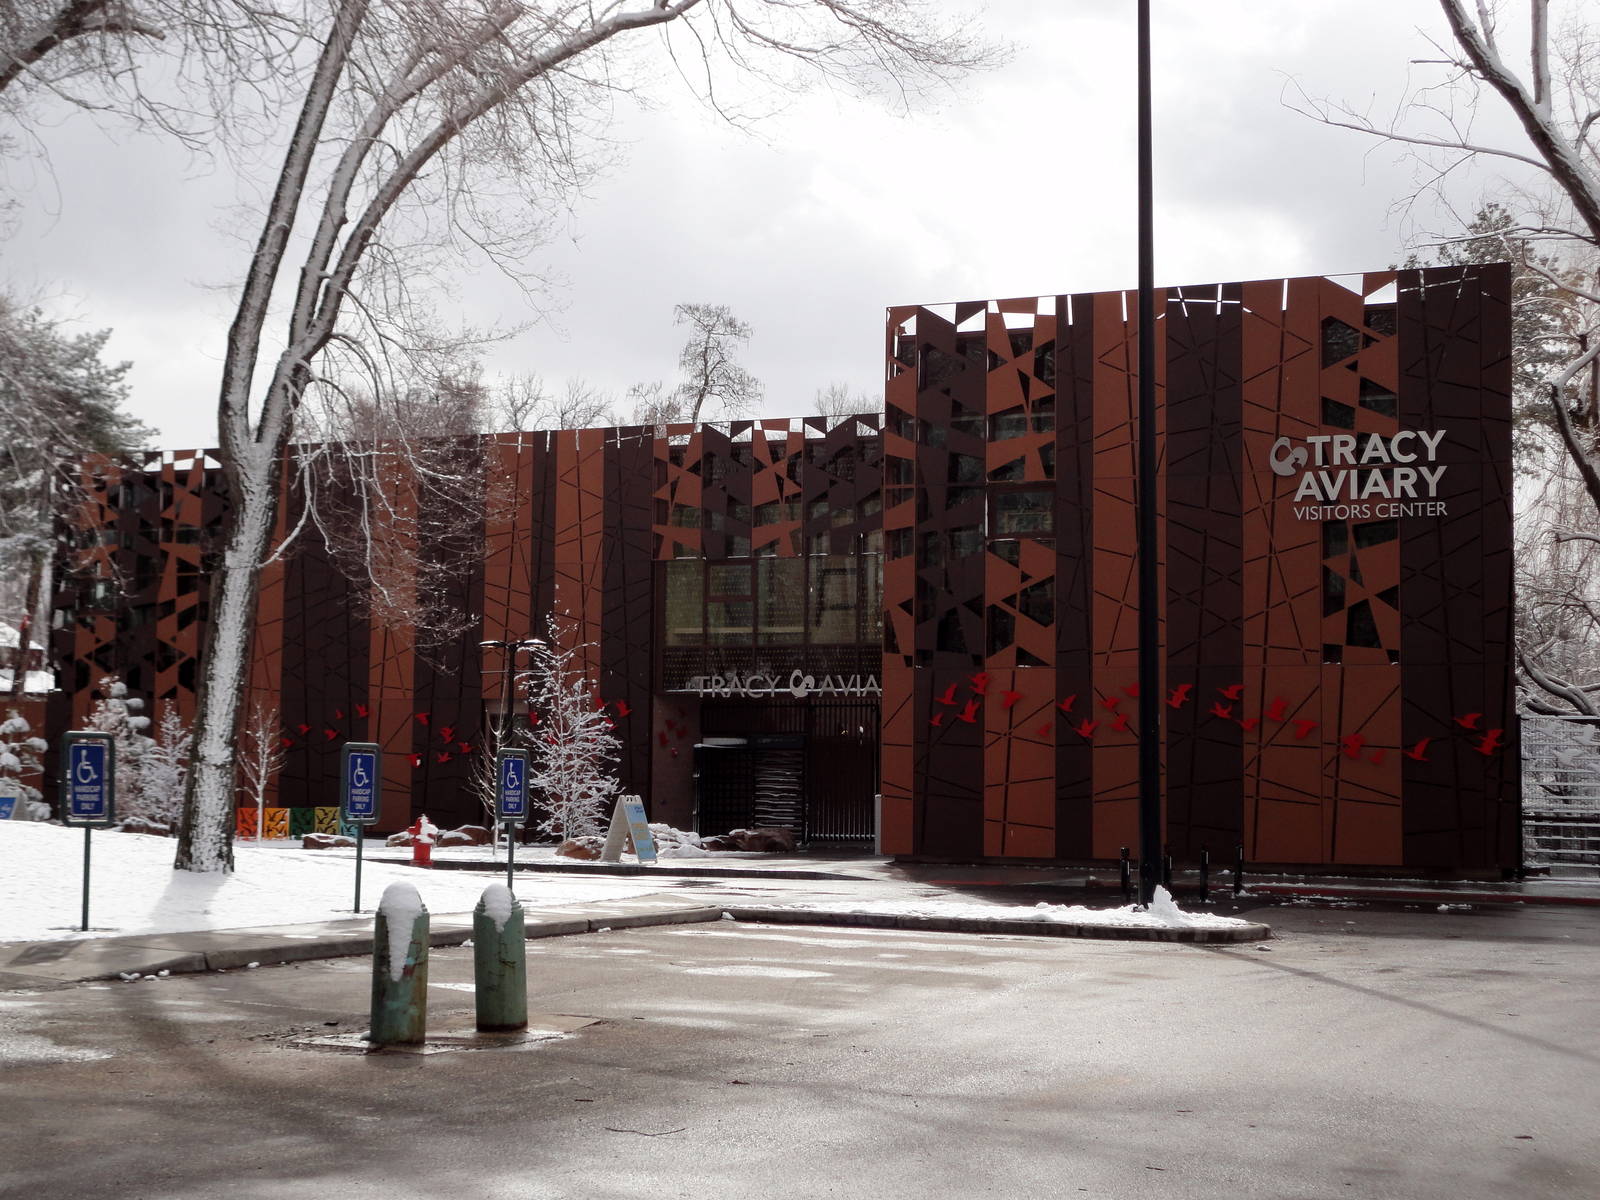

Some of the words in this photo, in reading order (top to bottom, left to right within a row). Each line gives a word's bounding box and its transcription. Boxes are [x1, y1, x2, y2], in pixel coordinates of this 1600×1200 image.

[1306, 429, 1447, 466] TRACY
[1293, 465, 1448, 502] AVIARY
[1293, 504, 1371, 520] VISITORS
[1375, 501, 1448, 518] CENTER
[695, 675, 782, 698] TRACY
